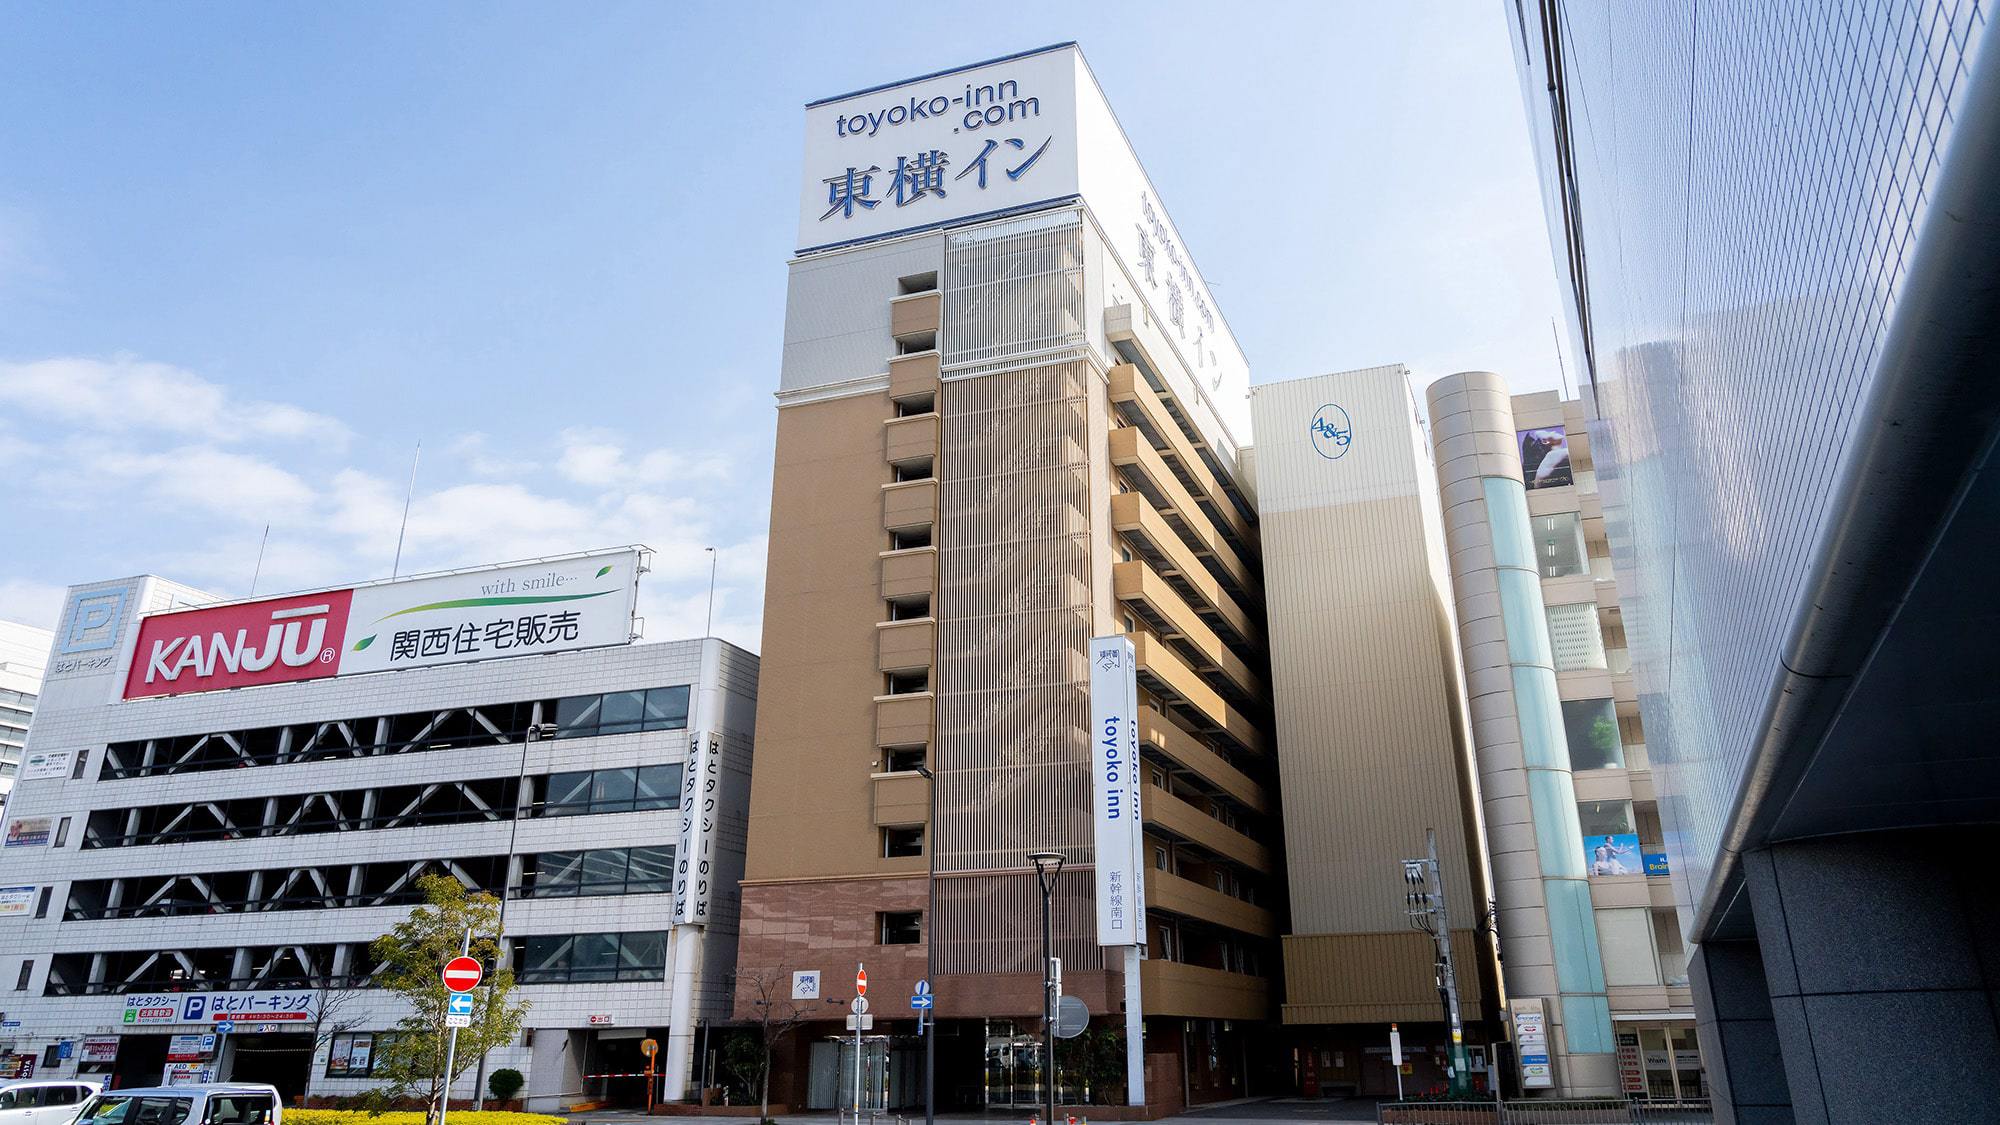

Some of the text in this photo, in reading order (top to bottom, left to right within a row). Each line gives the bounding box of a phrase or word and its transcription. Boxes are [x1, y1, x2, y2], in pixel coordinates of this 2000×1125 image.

[837, 79, 1018, 137] toyoko-inn
[818, 135, 1053, 222] 東横イン
[481, 578, 515, 596] with
[390, 610, 581, 661] 関西住宅販売
[1102, 716, 1123, 819] toyoko inn
[1130, 720, 1138, 784] toyoko
[675, 739, 699, 916] はとタクシーのりば
[696, 739, 719, 916] はとタクシーのりば
[1110, 870, 1123, 930] 新幹線南口
[127, 996, 178, 1007] はとタクシー
[211, 994, 312, 1011] はとパーキング
